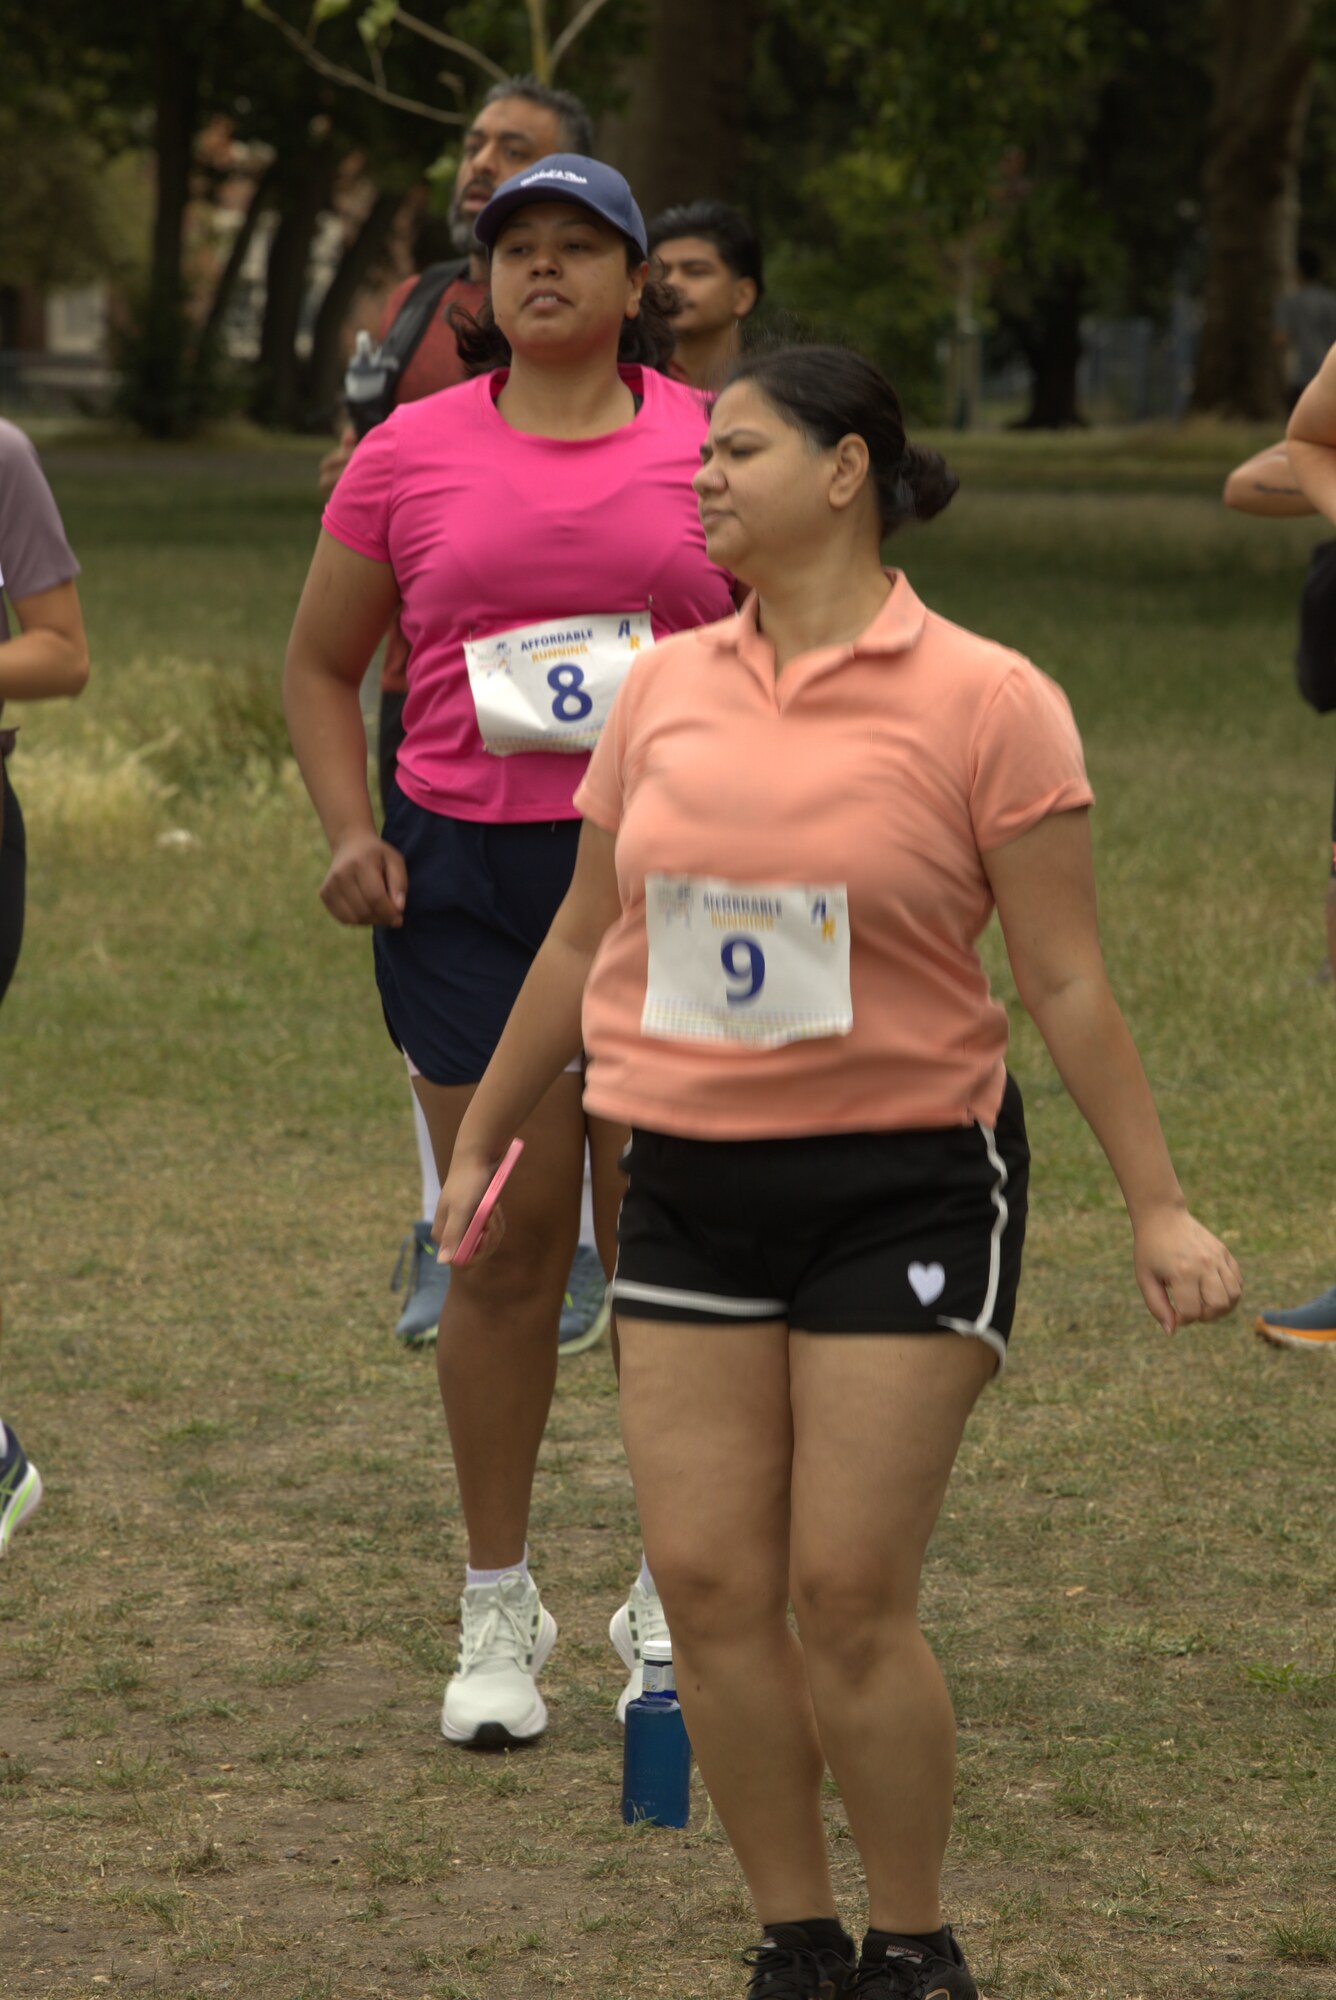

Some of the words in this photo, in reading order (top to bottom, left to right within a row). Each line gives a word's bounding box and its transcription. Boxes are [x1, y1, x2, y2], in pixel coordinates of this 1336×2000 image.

[521, 628, 593, 652] AFFORDABLE
[531, 644, 588, 664] RUNNING
[547, 662, 593, 723] 8
[720, 931, 765, 1009] 9
